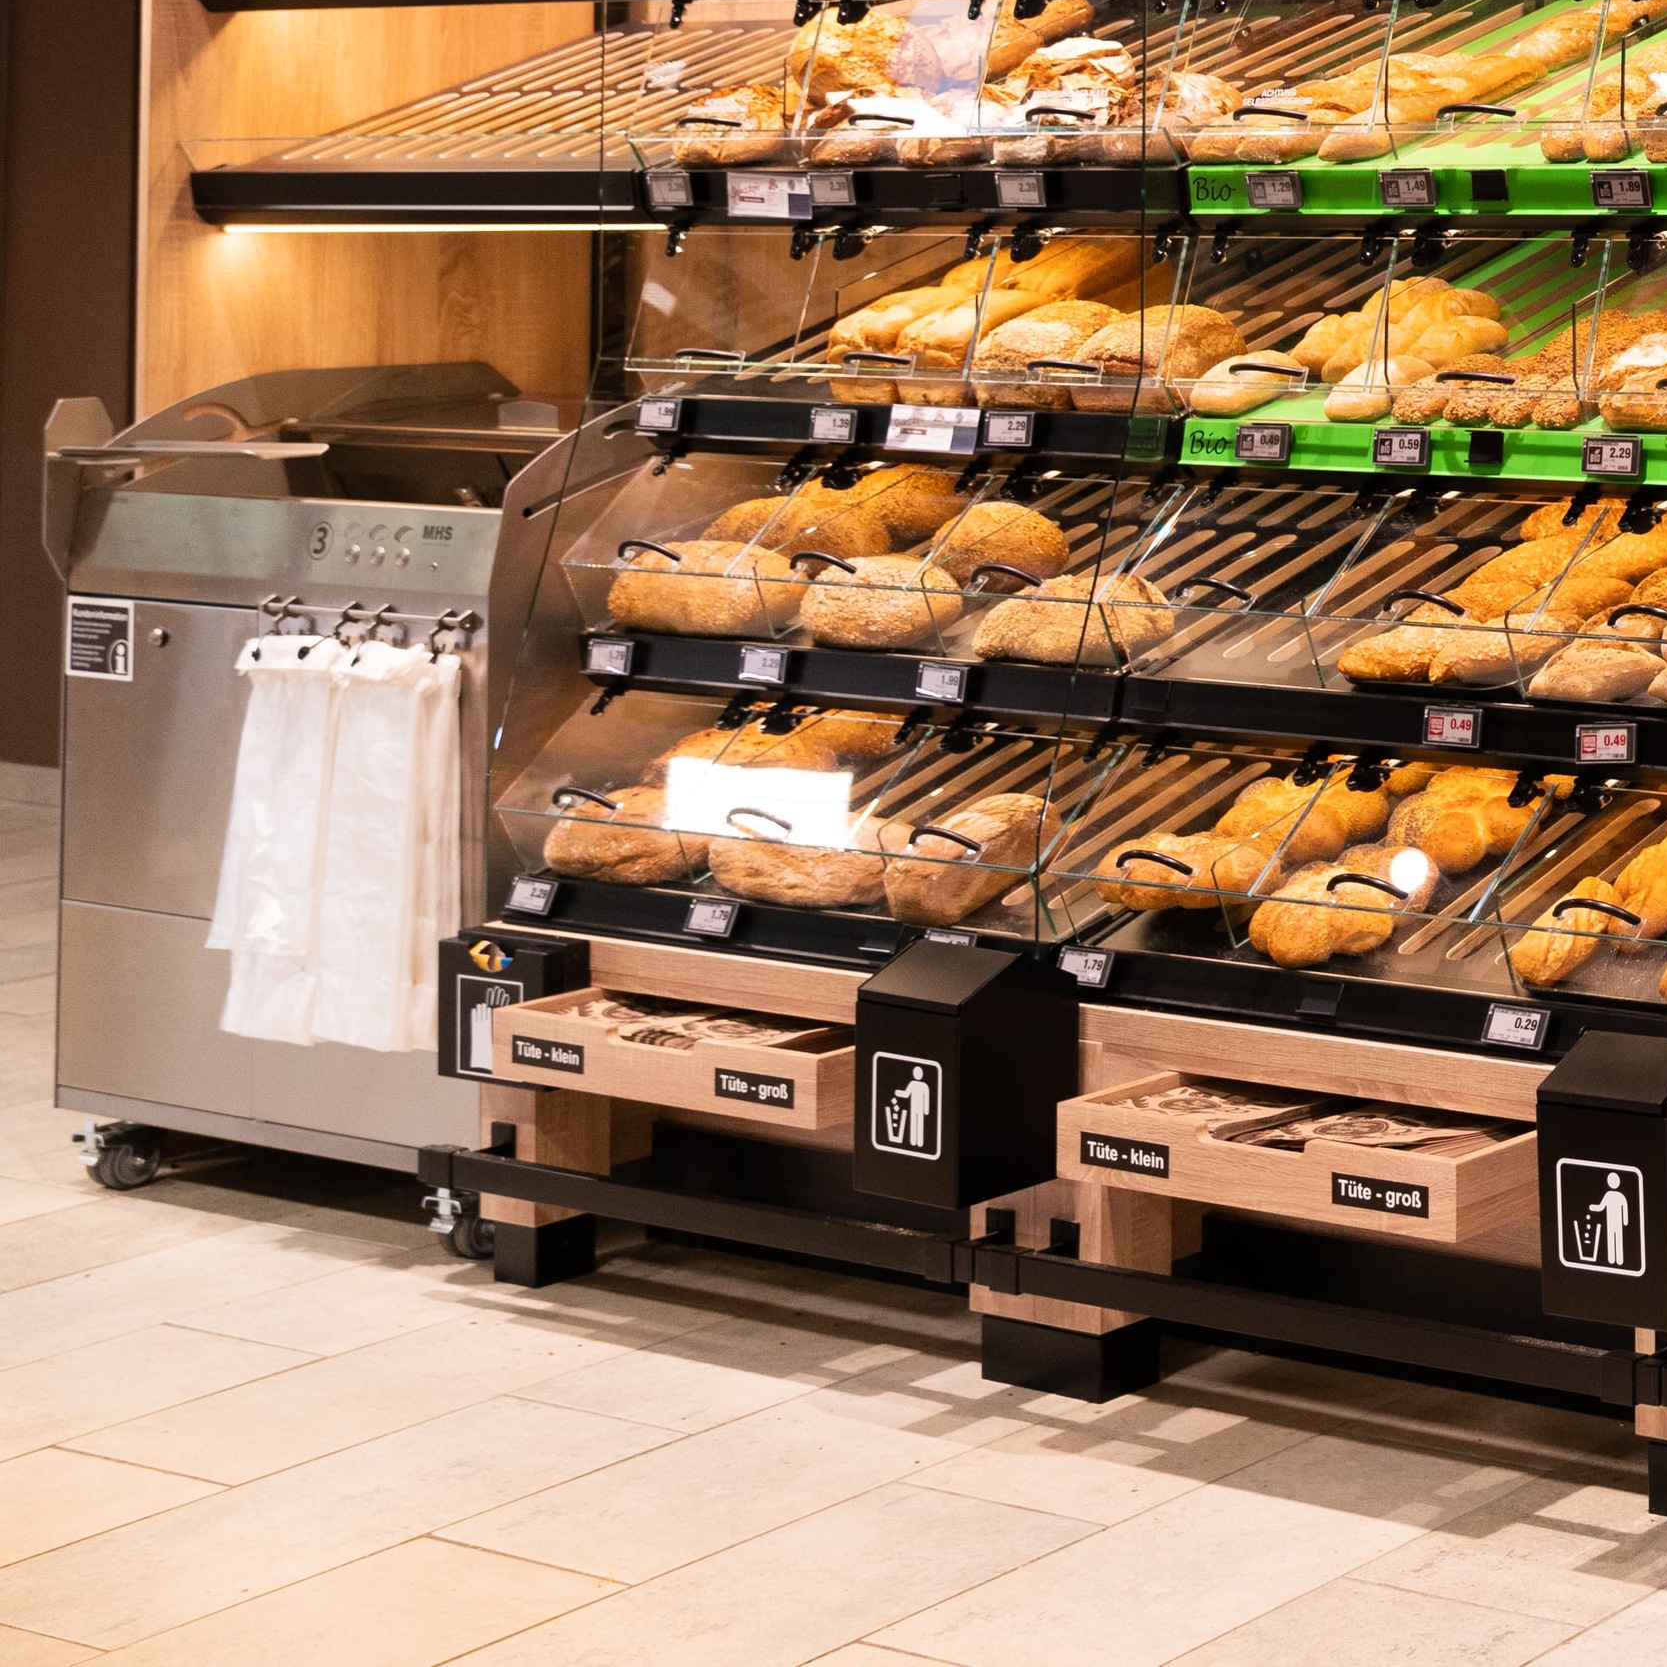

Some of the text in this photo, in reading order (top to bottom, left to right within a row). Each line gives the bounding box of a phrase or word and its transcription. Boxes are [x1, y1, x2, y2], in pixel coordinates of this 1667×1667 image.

[1019, 182, 1038, 193] 2.39
[1193, 177, 1237, 202] Bio
[1270, 181, 1291, 193] 1.29
[1404, 180, 1426, 192] 1.49
[1619, 180, 1641, 193] 1.89
[832, 417, 849, 429] 1.39
[1007, 419, 1026, 431] 2.29
[1190, 430, 1235, 455] Bio
[1259, 432, 1280, 446] 0.49
[1398, 437, 1420, 451] 0.59
[1609, 446, 1632, 460] 2.29
[422, 525, 453, 542] MHS
[940, 674, 959, 687] 1.99
[1450, 717, 1473, 732] 0.49
[1603, 734, 1627, 748] 0.49
[1083, 959, 1104, 973] 1.79
[1513, 1016, 1539, 1032] 0.29
[516, 1040, 543, 1060] Tüte
[552, 1047, 581, 1067] klein
[720, 1074, 748, 1094] Tüte
[759, 1083, 790, 1101] groß
[1087, 1140, 1119, 1162] Tüte
[1131, 1148, 1165, 1171] klein
[1338, 1179, 1373, 1203] Tüte
[1385, 1189, 1422, 1209] groß
